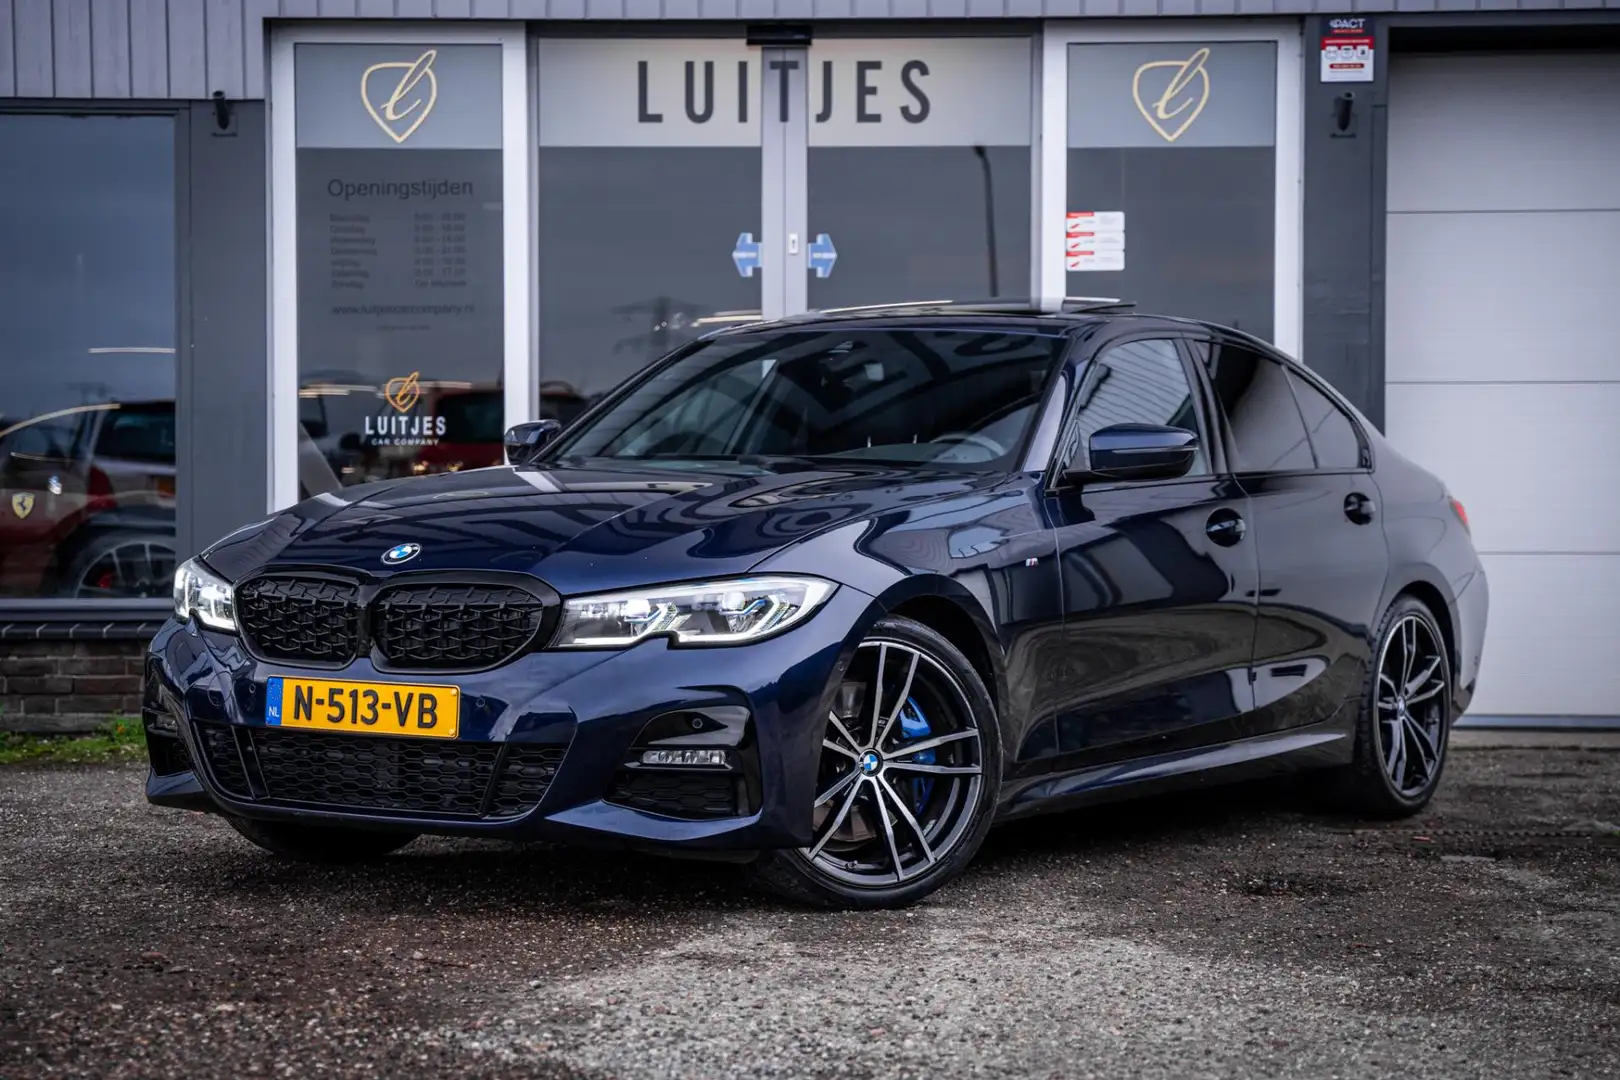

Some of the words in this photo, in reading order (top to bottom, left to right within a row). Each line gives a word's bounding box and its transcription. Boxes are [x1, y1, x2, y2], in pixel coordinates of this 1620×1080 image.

[637, 60, 931, 124] LUITJES
[327, 179, 473, 201] Openingstijden
[365, 415, 446, 436] LUITJES
[371, 438, 391, 446] CAR
[394, 438, 440, 446] COMPANY
[268, 706, 280, 718] NL
[293, 684, 438, 729] N-513-VB
